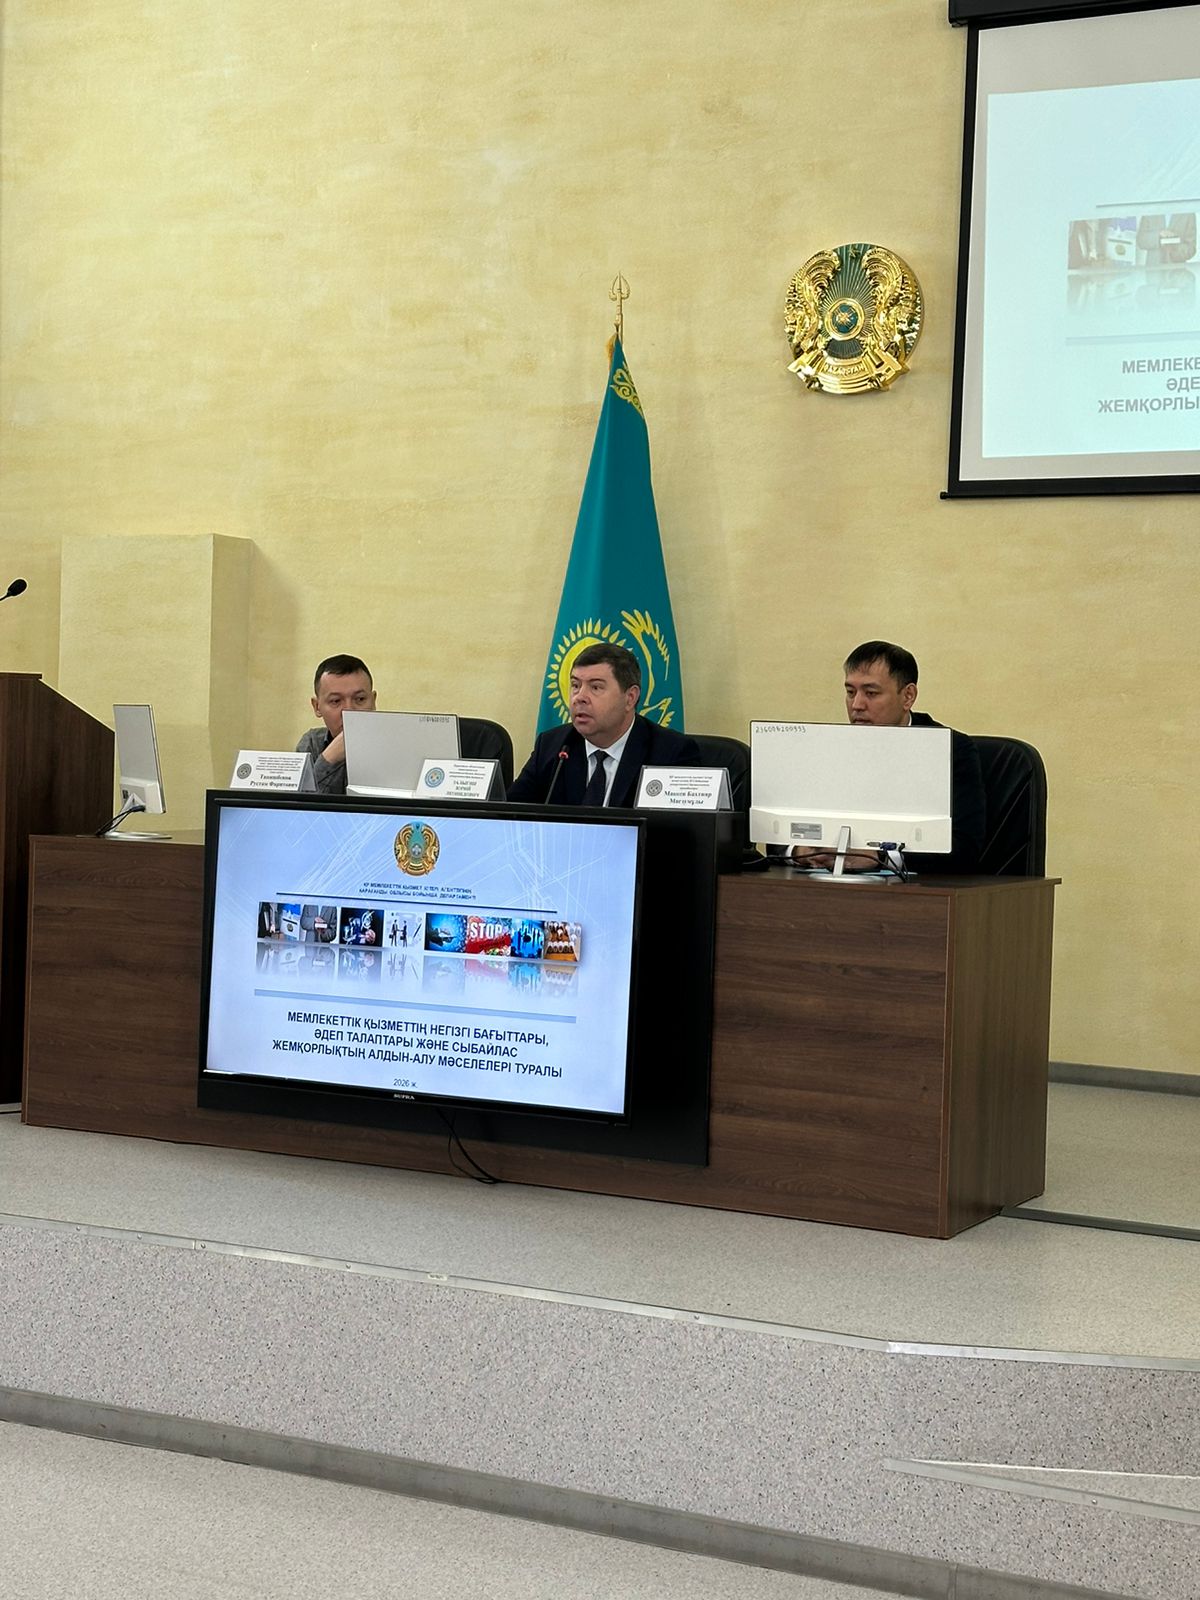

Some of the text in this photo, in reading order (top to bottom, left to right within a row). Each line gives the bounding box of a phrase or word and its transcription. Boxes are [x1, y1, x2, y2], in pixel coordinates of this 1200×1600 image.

[470, 922, 502, 939] STOP
[287, 1011, 549, 1047] МЕМЛЕКЕТТІК ҚЫЗМЕТТІҢ НЕГІЗГІ БАҒЫТТАРЫ,
[314, 1028, 518, 1058] ӘДЕП ТАЛАПТАРЫ ЖӘНЕ СЫБАЙЛАС
[272, 1039, 563, 1078] ЖЕМҚОРЛЫҚТЫҢ АЛДЫН-АЛУ МӘСЕЛЕЛЕРІ ТУРАЛЫ
